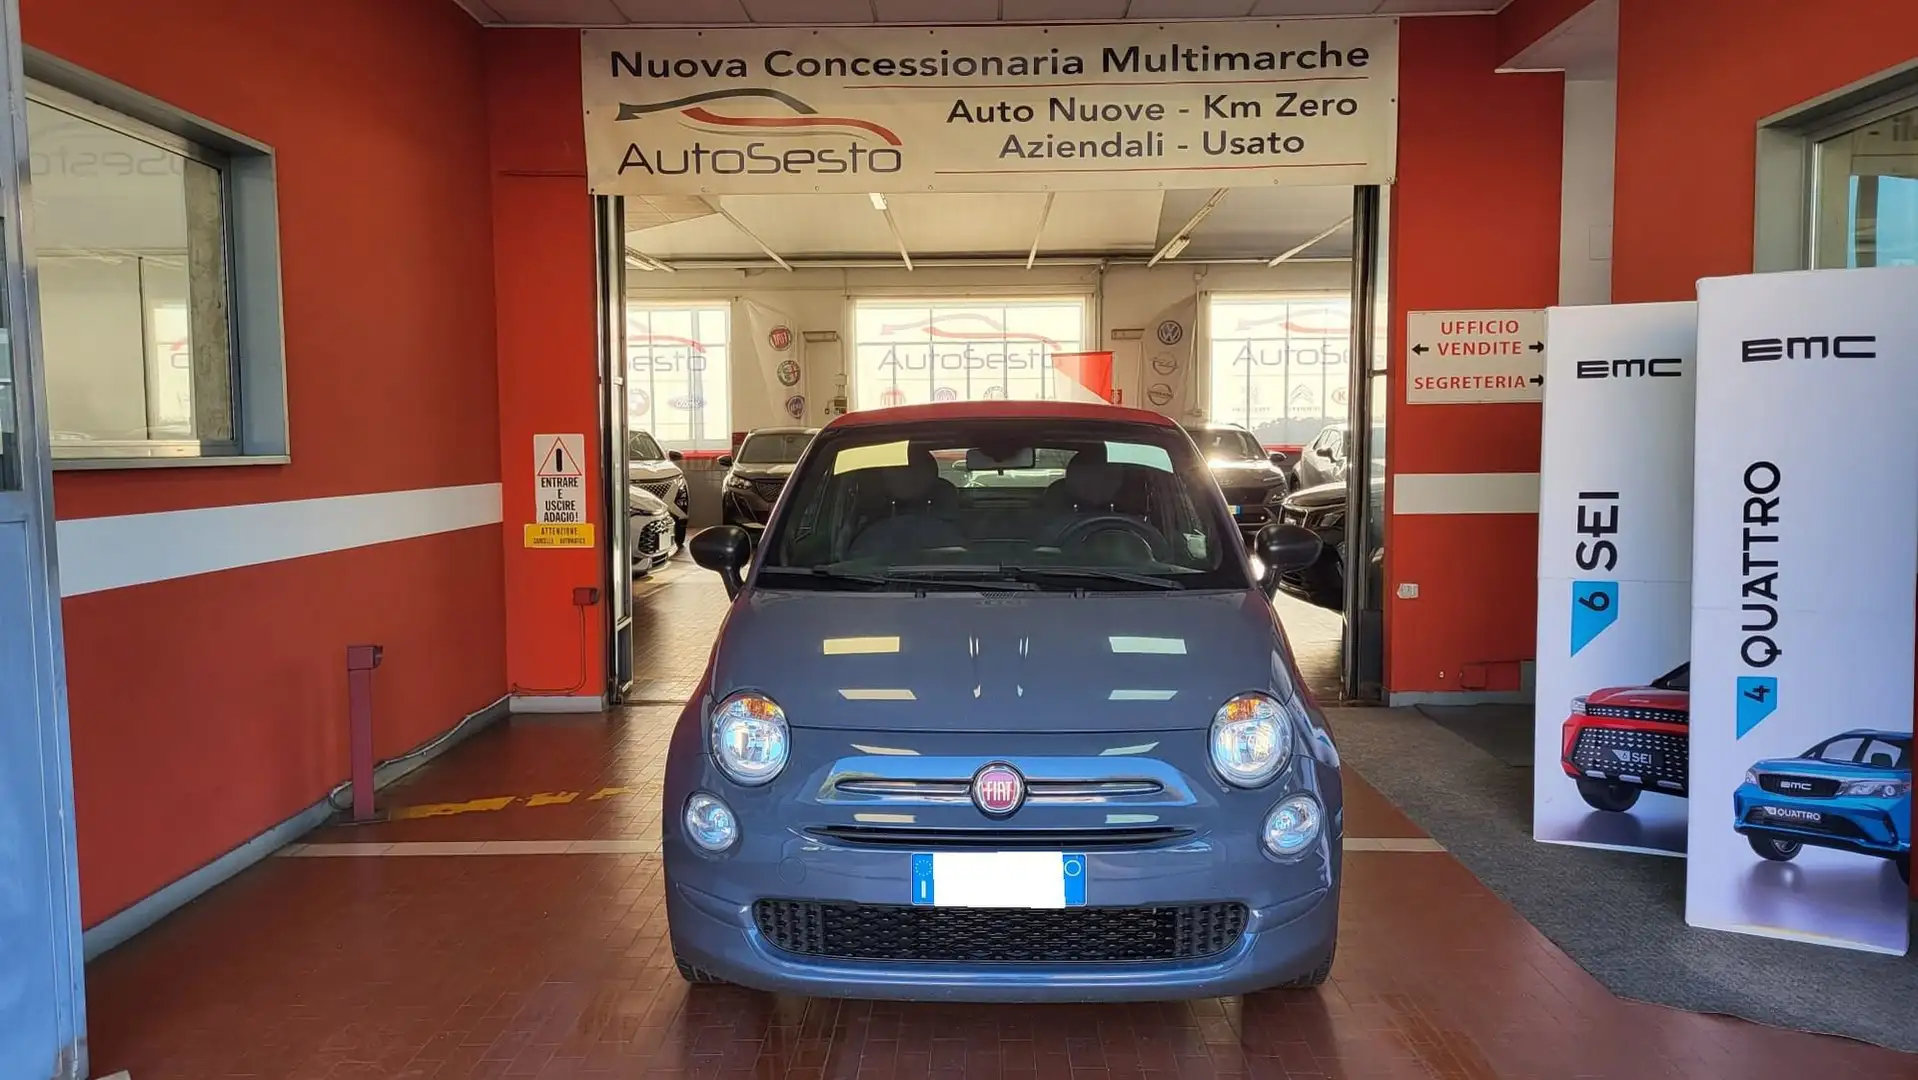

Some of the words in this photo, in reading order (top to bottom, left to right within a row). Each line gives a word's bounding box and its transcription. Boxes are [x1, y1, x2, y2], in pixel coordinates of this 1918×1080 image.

[610, 51, 748, 79] Nuova
[763, 49, 1084, 78] Concessionaria
[1101, 41, 1370, 74] Multimarche
[946, 99, 1034, 124] Auto
[1049, 97, 1165, 122] Nuove
[1204, 94, 1261, 119] Km
[1275, 92, 1358, 117] Zero
[998, 132, 1164, 159] Aziendali
[1202, 131, 1305, 156] Usato
[617, 141, 903, 176] AutoSesto
[1441, 320, 1519, 335] UFFICIO
[1232, 345, 1348, 366] AutoS
[1437, 341, 1522, 356] VENDITE
[1742, 336, 1876, 362] EMC
[629, 351, 707, 372] esto
[1577, 358, 1682, 378] EMC
[1414, 375, 1526, 390] SEGRETERIA
[541, 477, 579, 488] ENTRARE
[557, 489, 563, 499] E
[545, 500, 576, 511] USCIRE
[543, 512, 579, 523] ADAGIO!
[1575, 491, 1620, 572] SEI
[1740, 461, 1782, 668] QUATTRO
[1578, 591, 1611, 612] 6
[1744, 684, 1771, 703] 4
[1631, 752, 1652, 765] SEI
[984, 780, 1012, 801] FIAT
[1776, 808, 1821, 821] QUATTRO
